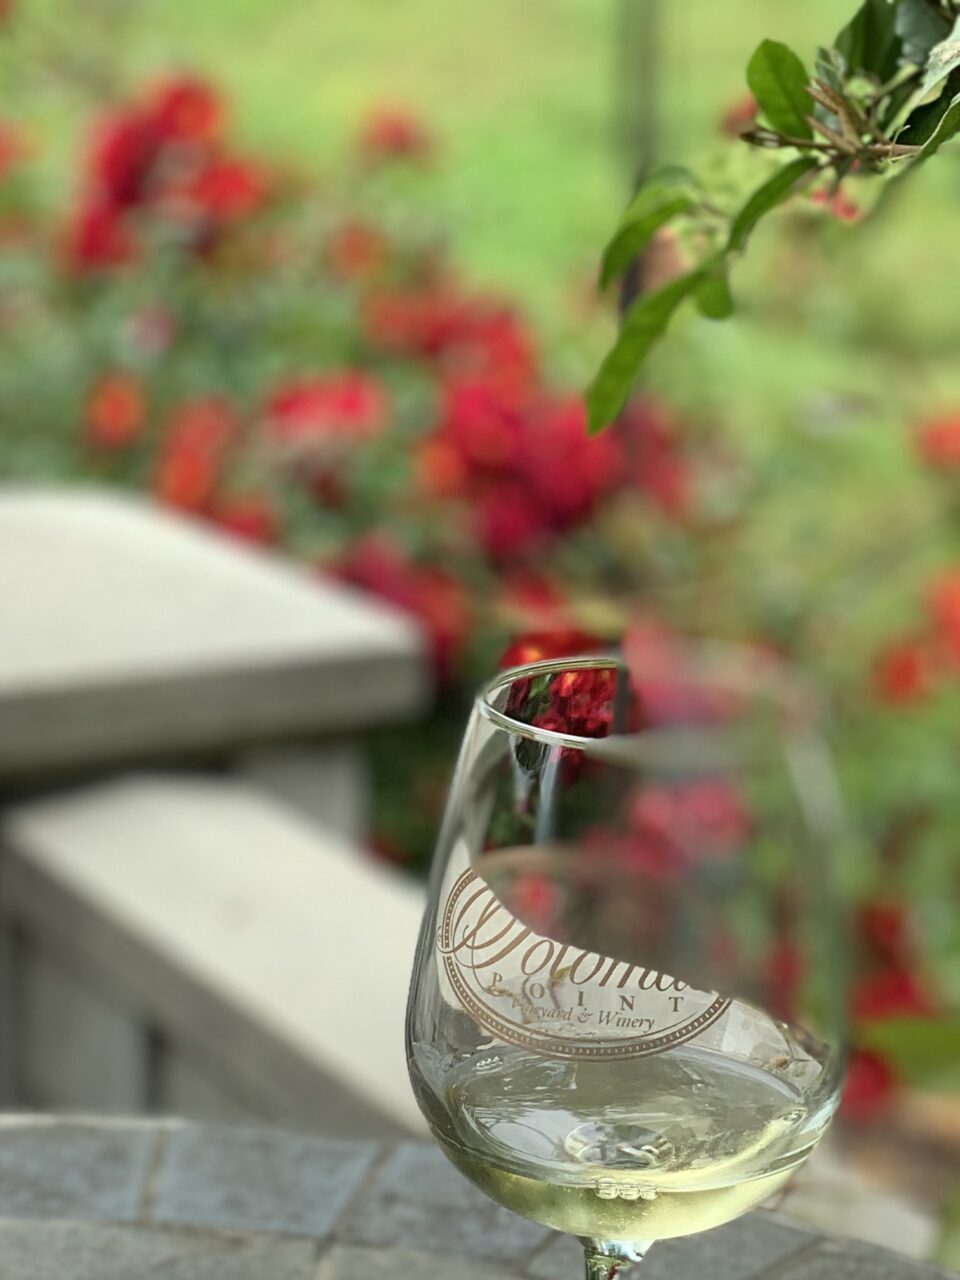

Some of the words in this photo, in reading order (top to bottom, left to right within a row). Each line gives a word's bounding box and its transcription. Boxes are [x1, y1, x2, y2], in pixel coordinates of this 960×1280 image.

[437, 882, 689, 993] Potom
[493, 972, 684, 1013] POINT
[578, 1007, 593, 1023] &
[599, 1009, 655, 1034] Winery
